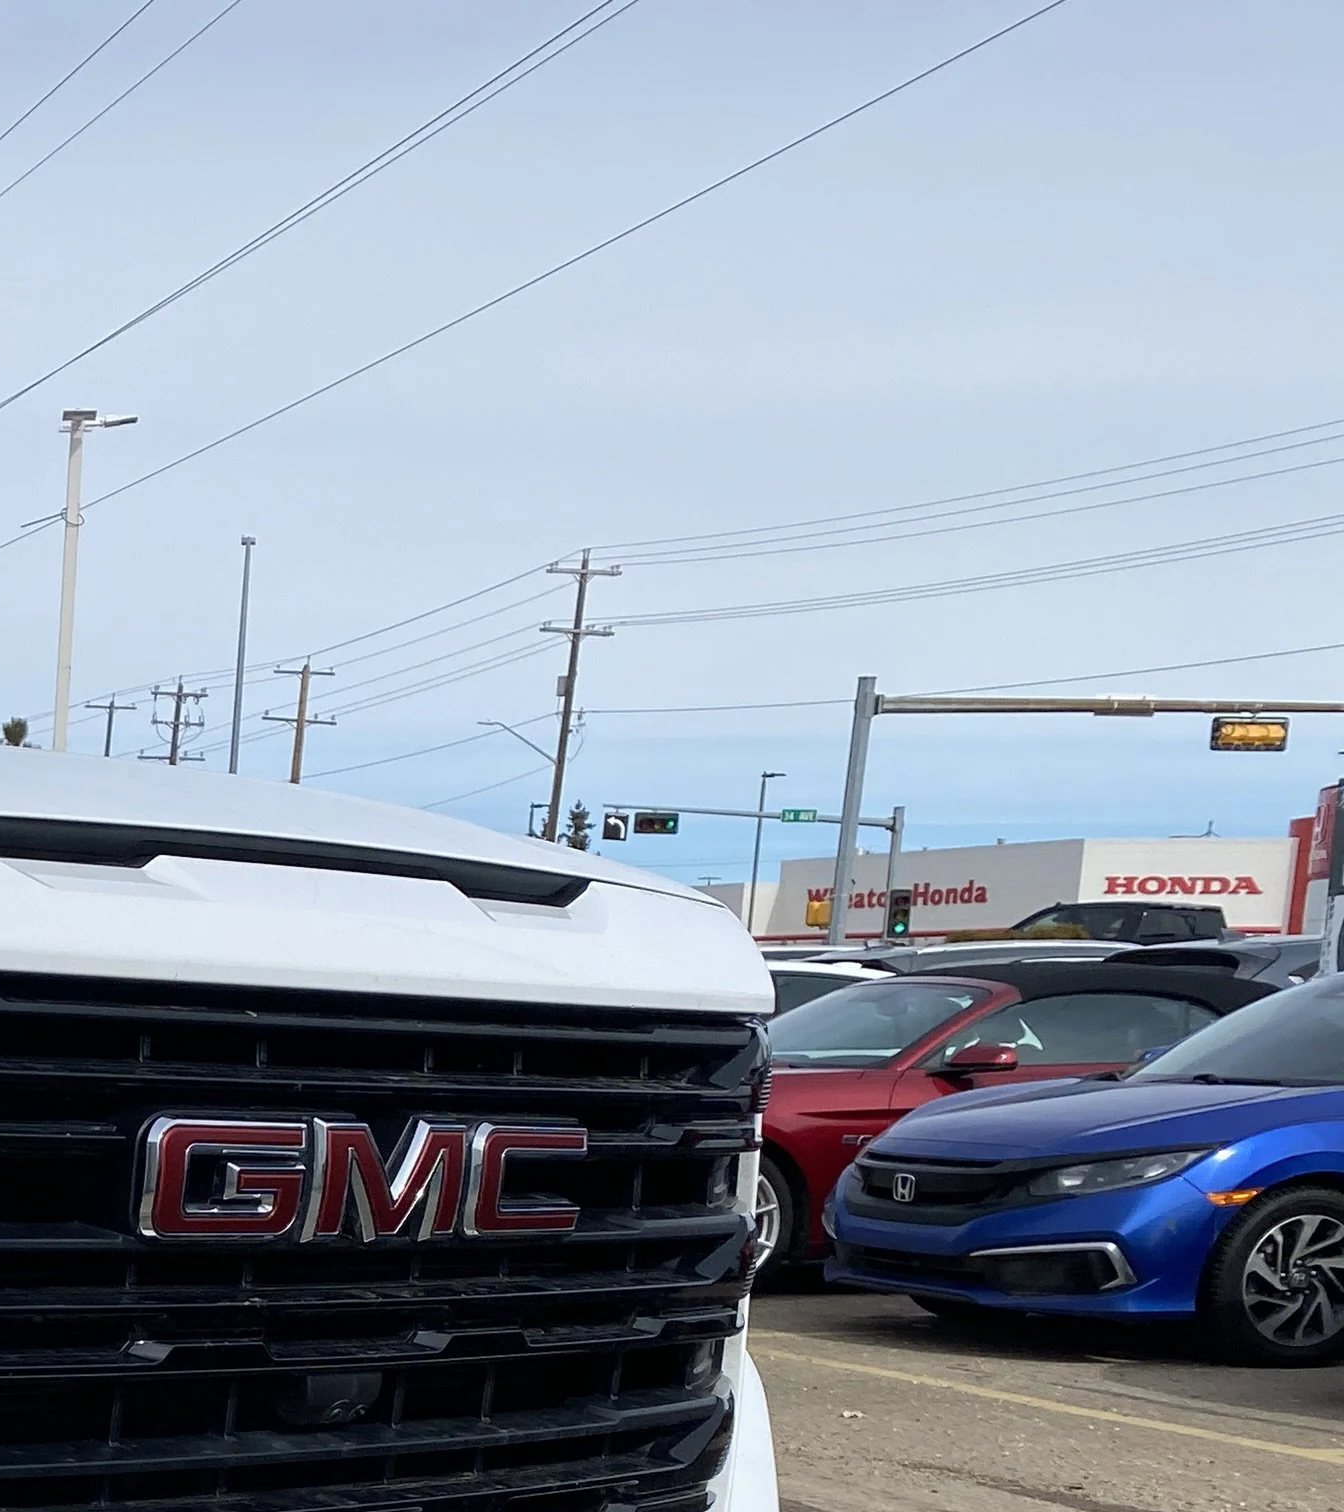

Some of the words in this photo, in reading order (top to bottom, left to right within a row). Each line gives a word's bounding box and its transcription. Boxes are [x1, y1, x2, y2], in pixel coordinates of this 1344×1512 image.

[912, 879, 988, 906] Honda
[1103, 876, 1264, 895] HONDA
[138, 1115, 589, 1242] GMC
